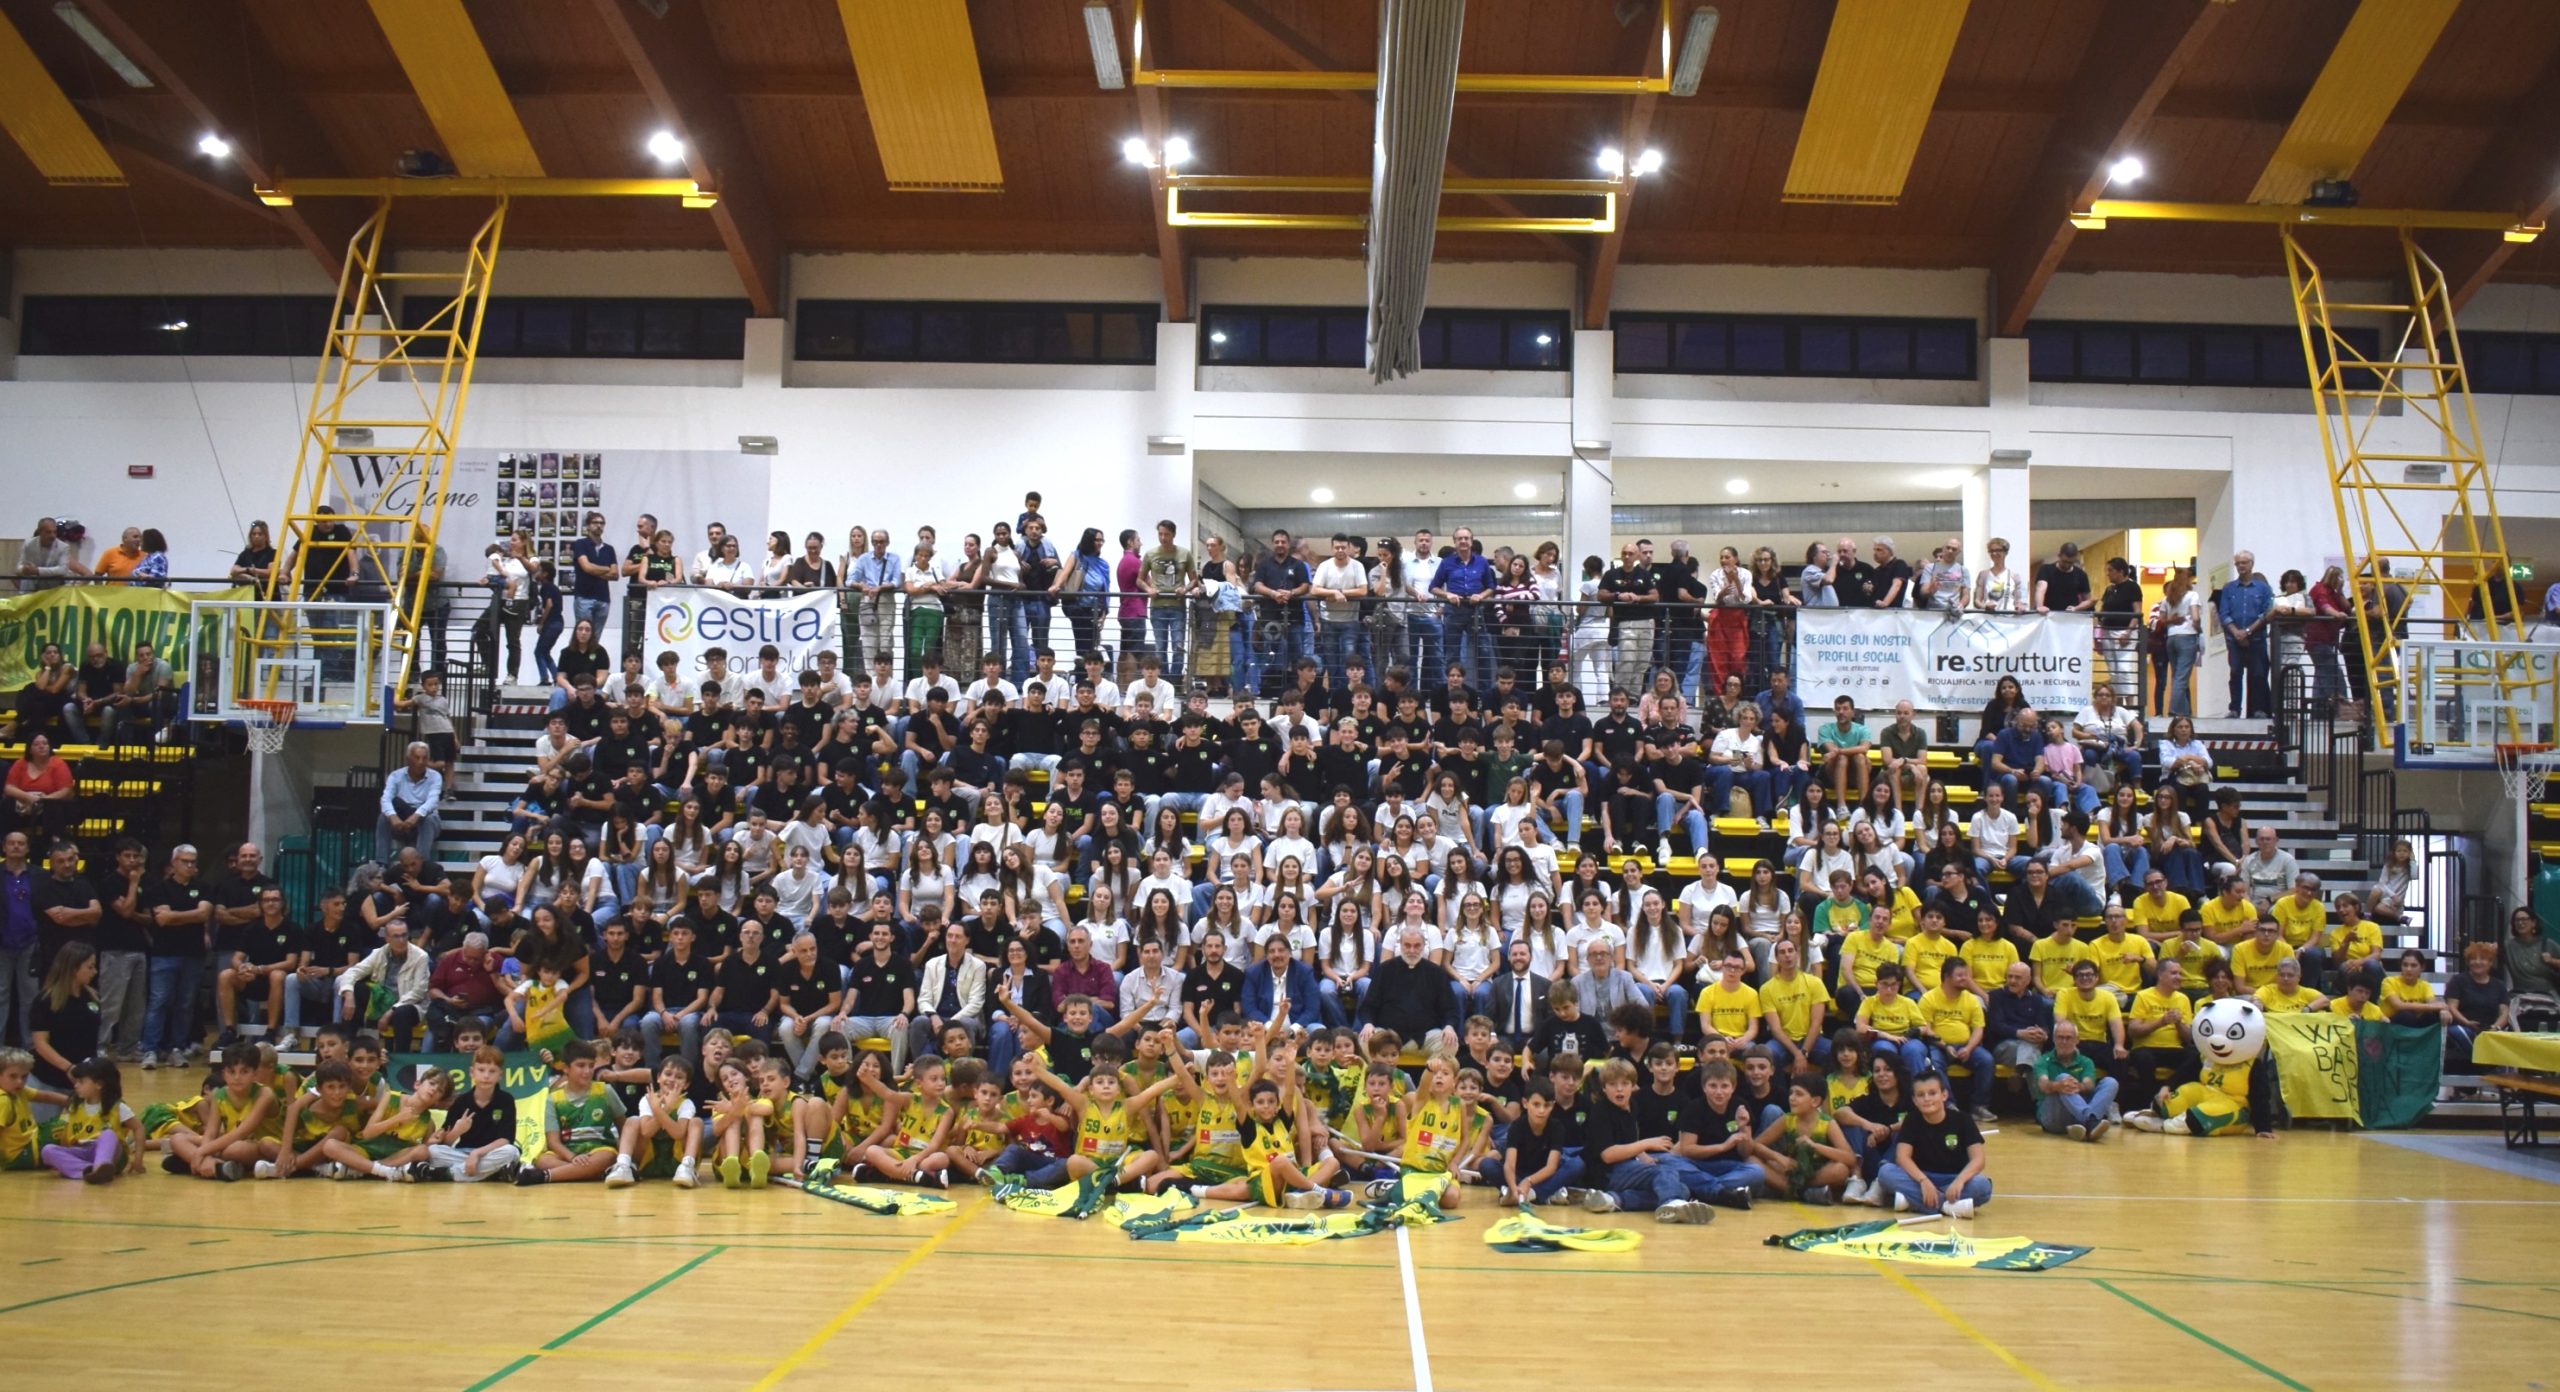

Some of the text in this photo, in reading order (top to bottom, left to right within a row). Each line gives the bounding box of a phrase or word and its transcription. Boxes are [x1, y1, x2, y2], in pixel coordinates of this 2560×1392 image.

[697, 605, 822, 642] estra
[1803, 633, 1912, 647] SEGUICI SUI NOSTRI
[1818, 651, 1901, 663] PROFILI SOCIAL
[1937, 652, 2082, 674] re.strutture
[1927, 678, 2081, 687] RIQUALIFICA RISTURA RECUPERA
[2030, 696, 2048, 705] 376
[2049, 695, 2067, 705] 232
[2291, 1023, 2351, 1049] WE
[2207, 1072, 2225, 1089] 24
[1085, 1118, 1100, 1133] 59
[1421, 1111, 1436, 1127] 10
